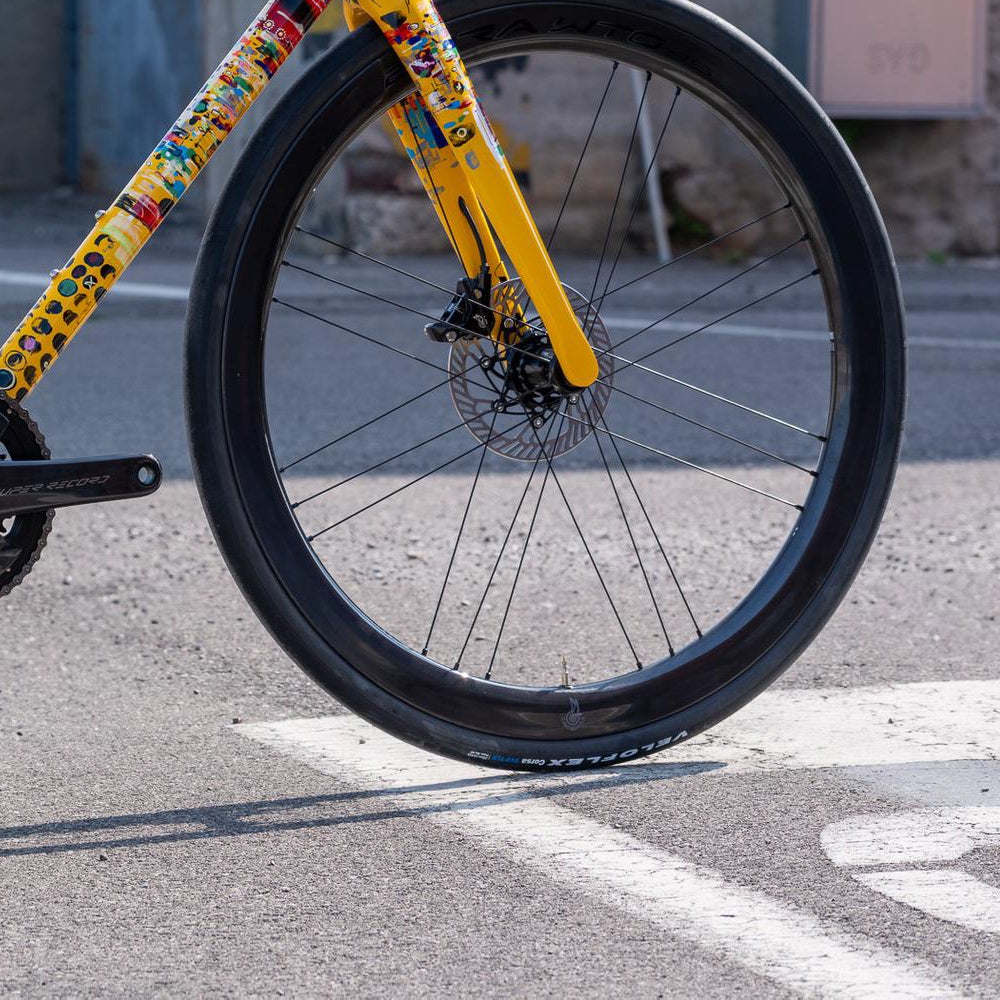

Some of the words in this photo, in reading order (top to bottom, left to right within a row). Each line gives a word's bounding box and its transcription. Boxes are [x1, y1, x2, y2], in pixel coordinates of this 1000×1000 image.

[46, 475, 111, 490] RECORD
[546, 730, 688, 767] VELOFLEX
[521, 757, 546, 767] Corsa
